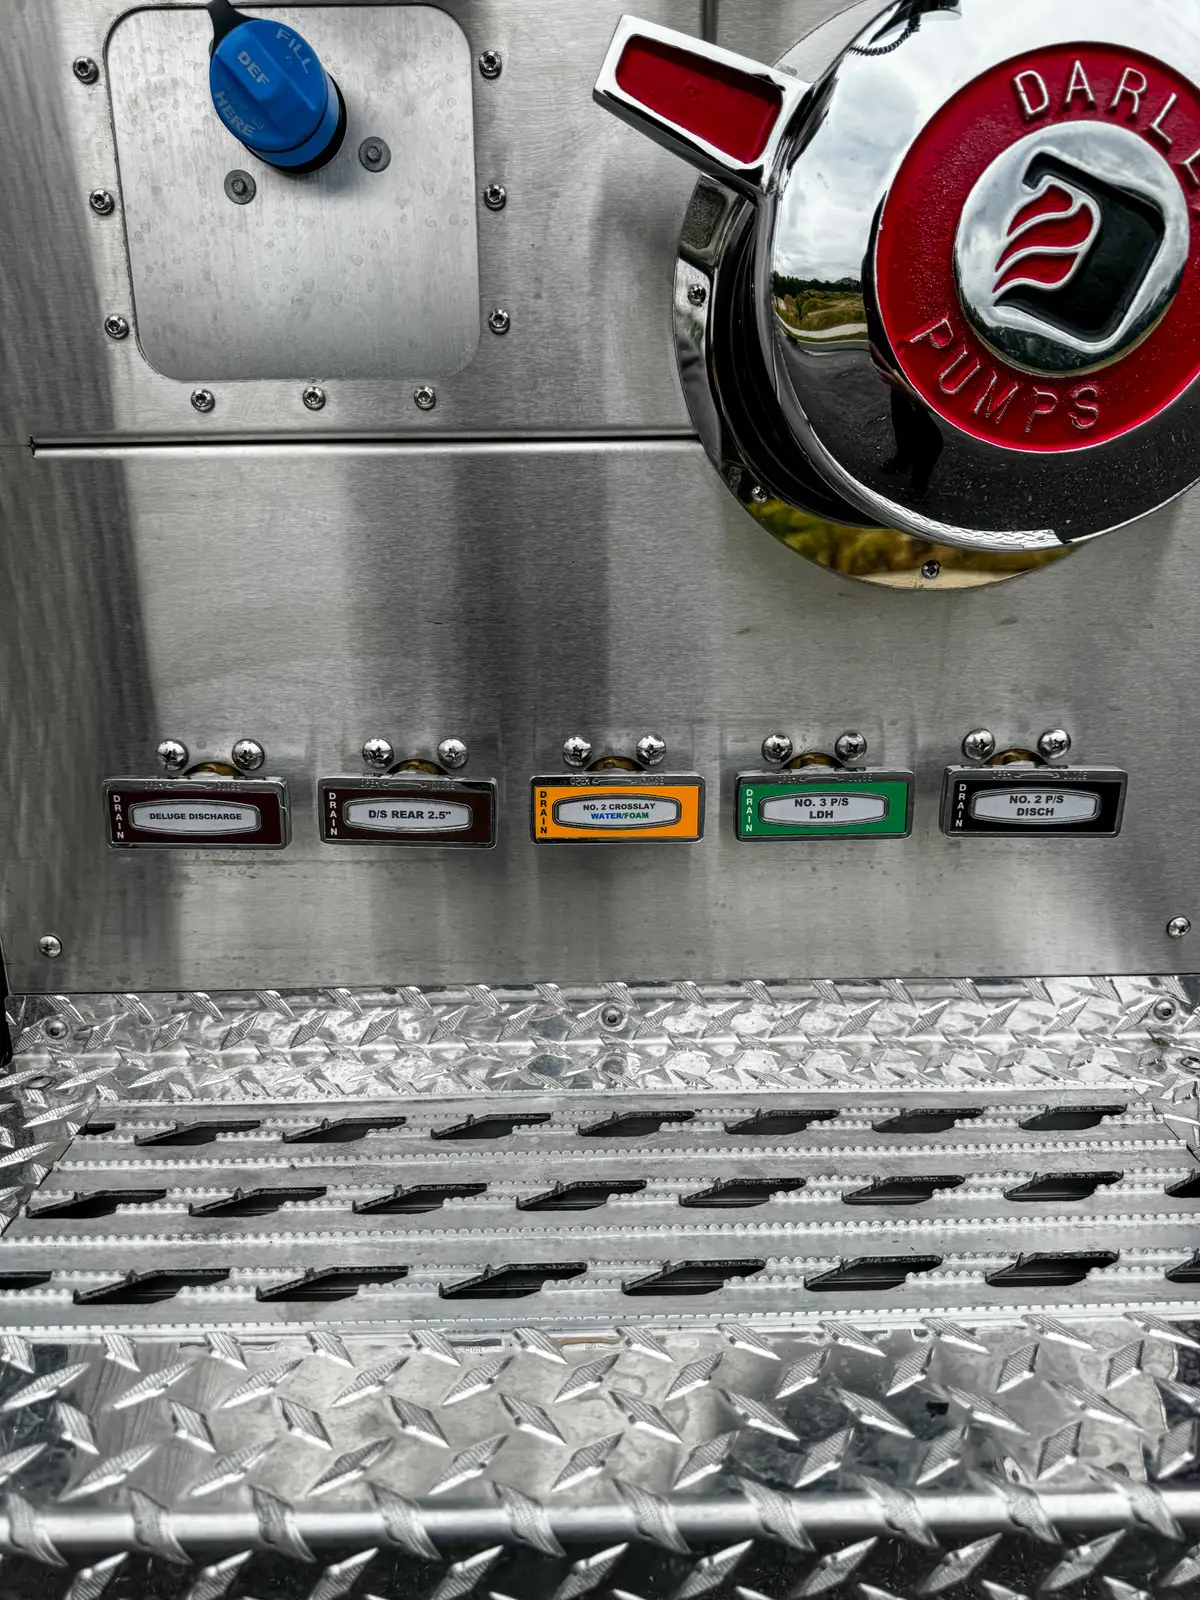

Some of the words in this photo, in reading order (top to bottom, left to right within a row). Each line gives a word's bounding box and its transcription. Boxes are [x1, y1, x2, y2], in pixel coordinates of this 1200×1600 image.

[275, 27, 312, 74] FILL
[237, 50, 270, 86] DEF
[213, 90, 256, 138] HERE
[909, 316, 1100, 434] PUMPS
[569, 777, 590, 786] OPEN
[608, 802, 656, 811] CROSSLAY
[745, 789, 753, 832] DRAIN
[794, 798, 816, 807] NO.
[819, 798, 827, 807] 3
[830, 797, 850, 807] P/S
[955, 783, 967, 827] DRAIN
[1009, 795, 1031, 804] NO.
[1034, 795, 1042, 804] 2
[1044, 794, 1064, 804] P/S
[113, 794, 125, 839] DRAIN
[149, 812, 187, 820] DELUGE
[188, 812, 242, 820] DISCHARGE
[328, 792, 338, 836] DRAIN
[368, 809, 388, 819] D/S
[391, 810, 425, 819] REAR
[427, 810, 452, 820] 2.5"
[539, 791, 548, 834] DRAIN
[590, 811, 650, 820] WATER/FOAM
[808, 810, 834, 819] LDH
[1016, 807, 1054, 816] DISCH
